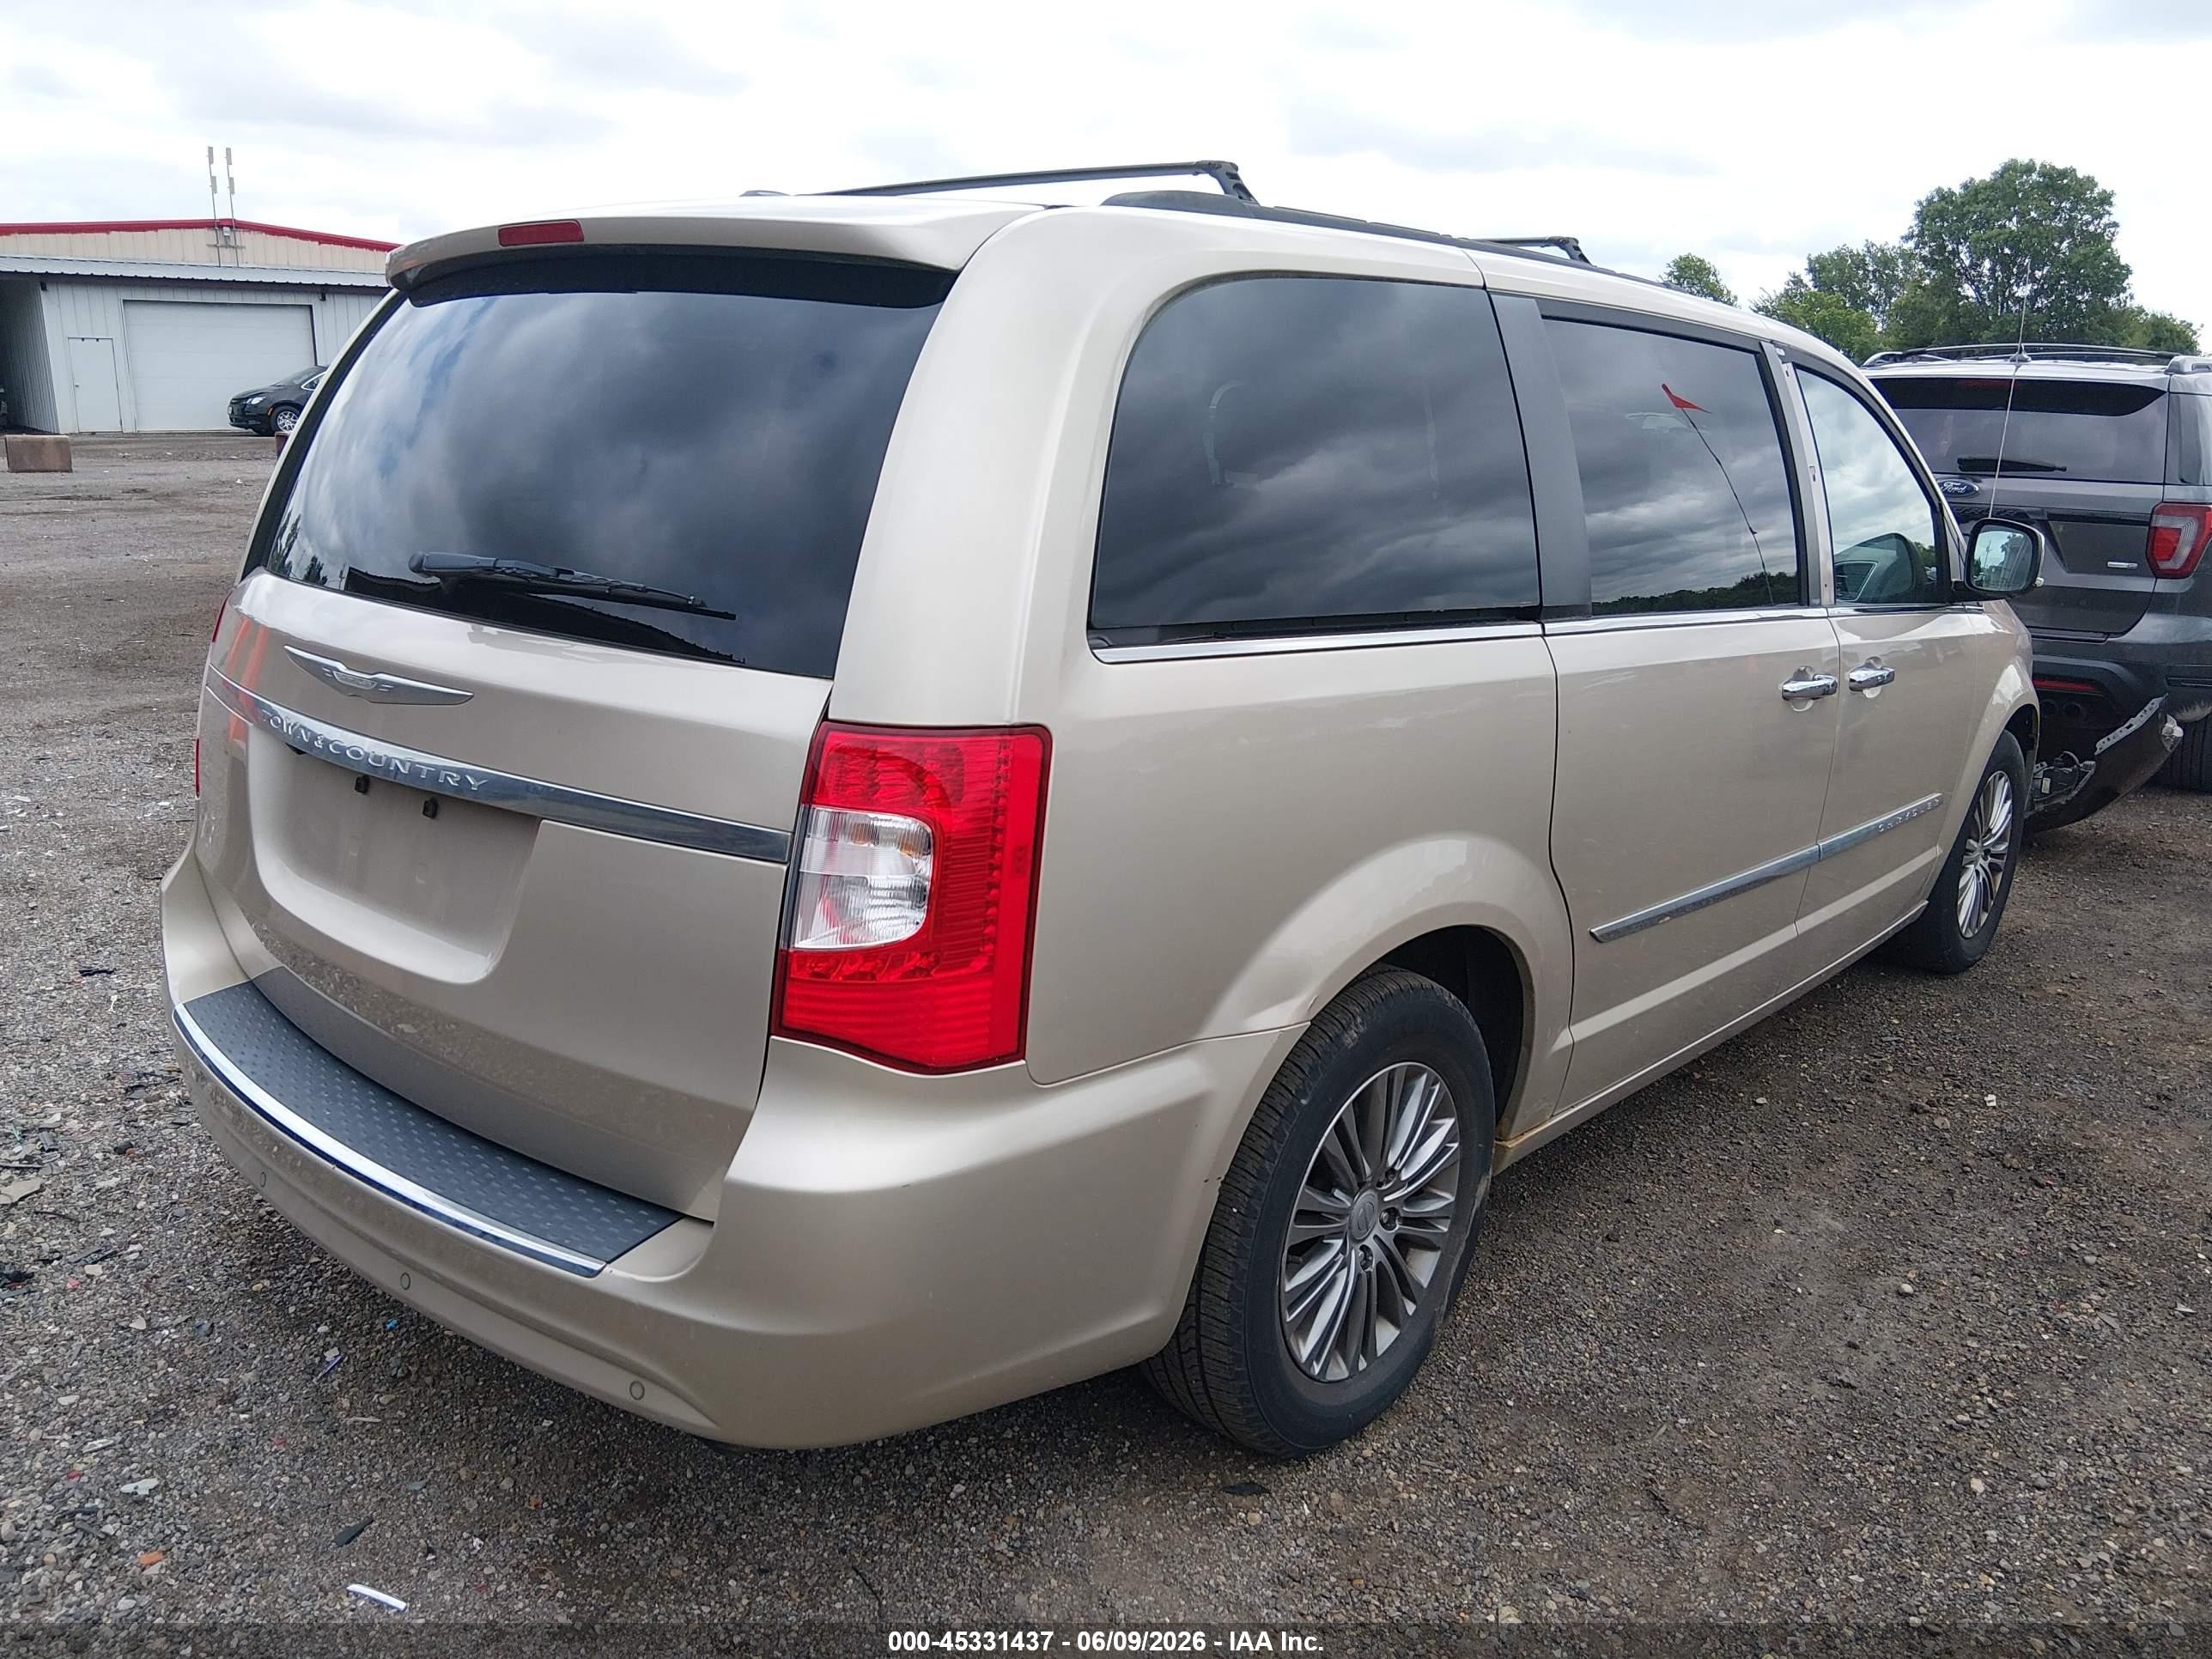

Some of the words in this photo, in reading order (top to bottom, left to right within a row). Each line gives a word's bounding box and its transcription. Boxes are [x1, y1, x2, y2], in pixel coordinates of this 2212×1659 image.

[1940, 481, 1968, 494] Ford
[261, 708, 312, 743] TOWN
[313, 733, 325, 750] &
[328, 738, 489, 791] COUNTRY
